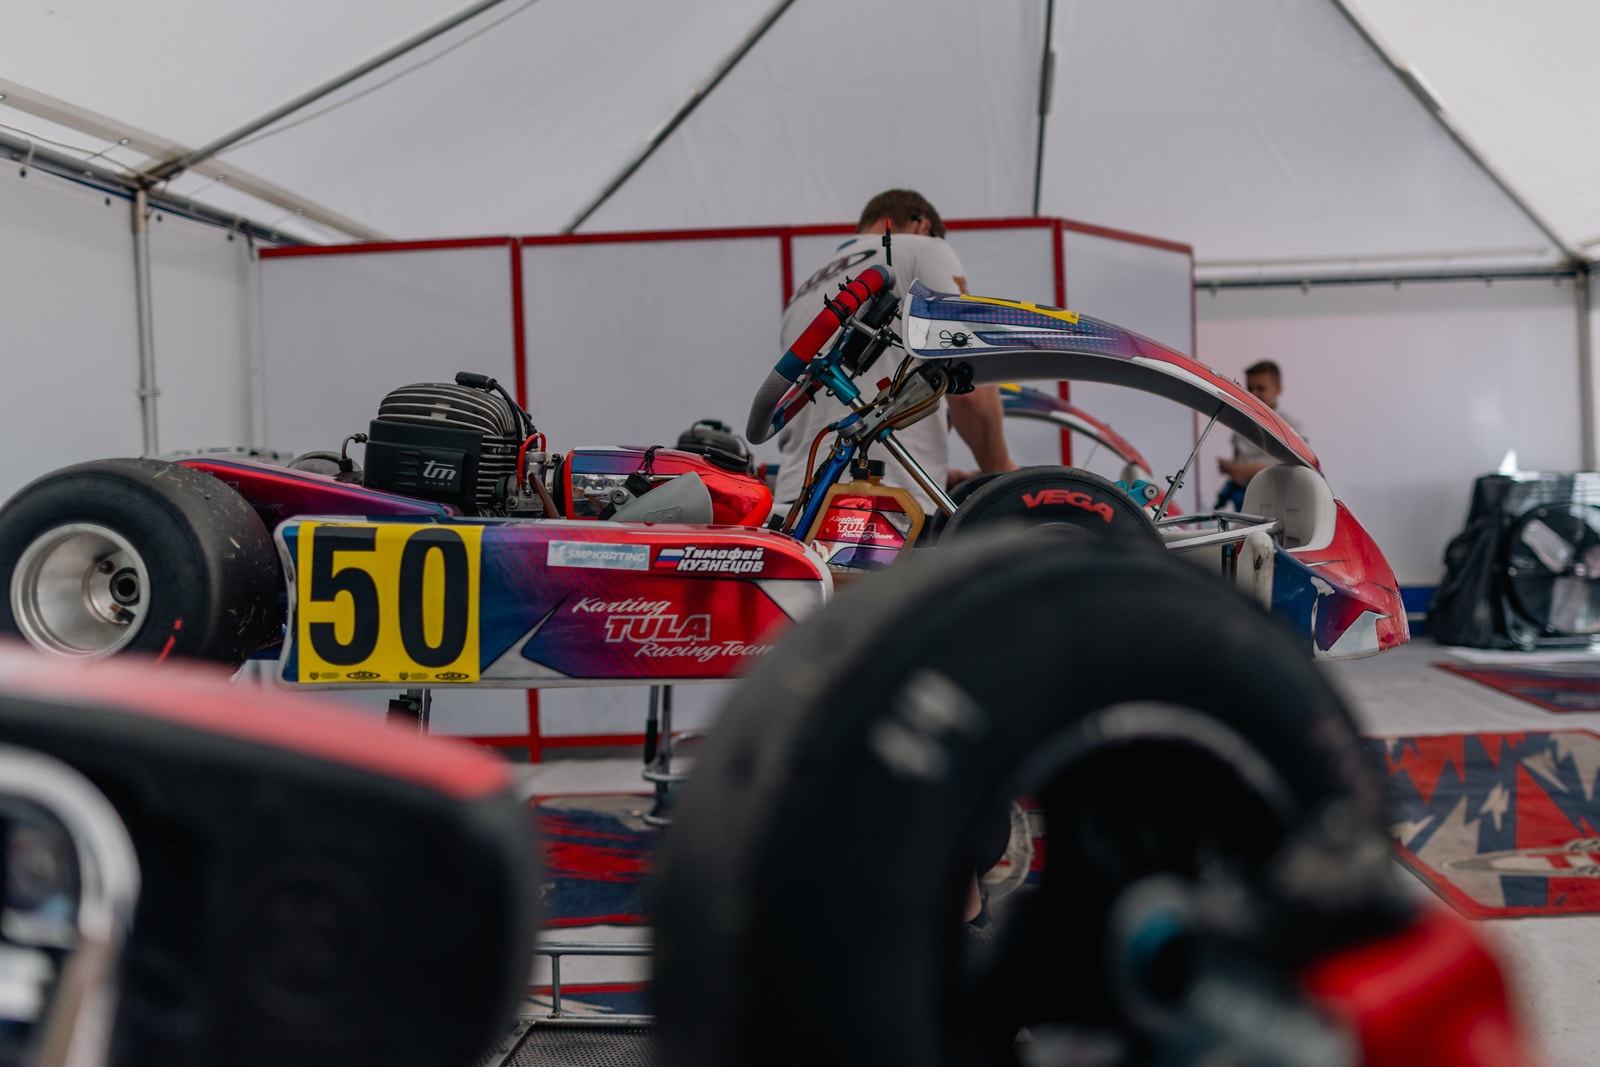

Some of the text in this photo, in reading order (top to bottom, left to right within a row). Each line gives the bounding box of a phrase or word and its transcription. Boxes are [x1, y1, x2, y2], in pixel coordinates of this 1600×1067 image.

[1022, 489, 1114, 523] VEGA
[837, 522, 876, 533] TULA
[683, 546, 764, 560] Тимофей
[676, 559, 764, 573] КУЗНЕЦОВ
[309, 526, 469, 668] 50
[571, 597, 672, 616] Karting
[604, 614, 711, 643] TULA
[634, 641, 722, 663] Racing
